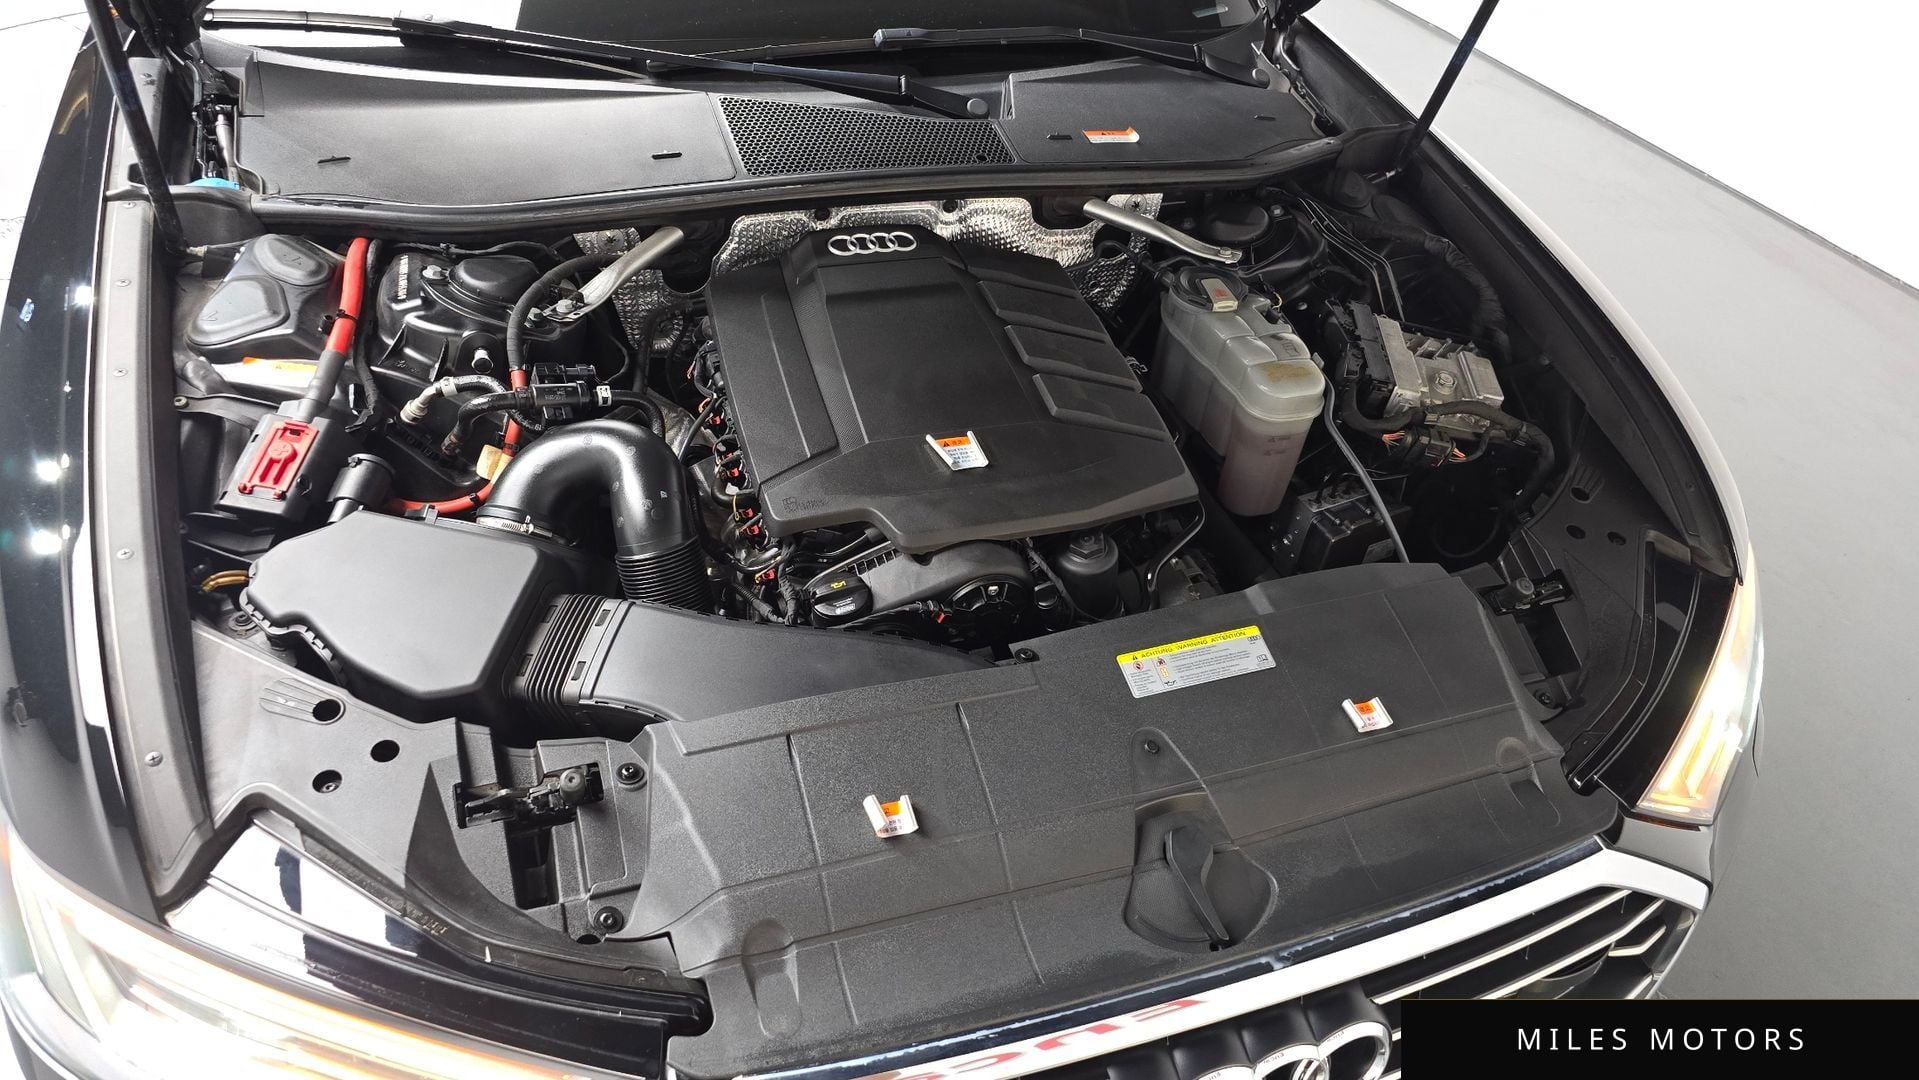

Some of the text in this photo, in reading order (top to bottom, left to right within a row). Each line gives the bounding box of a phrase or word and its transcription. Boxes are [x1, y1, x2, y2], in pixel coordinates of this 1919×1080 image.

[1141, 631, 1247, 658] ACHTUNG WARNING ATTENTION
